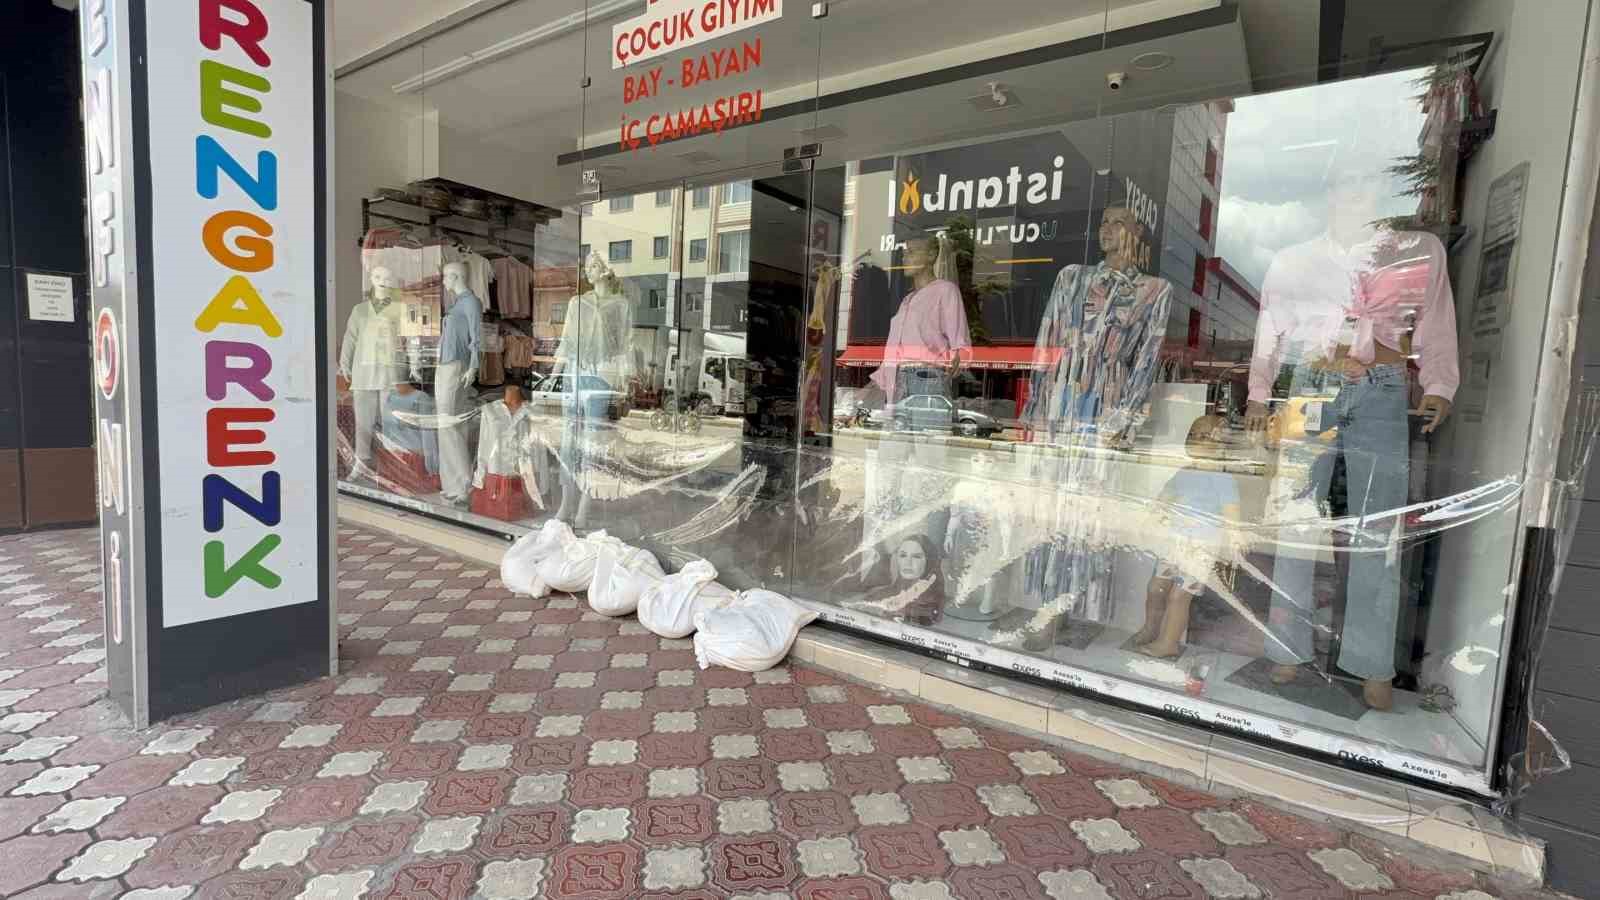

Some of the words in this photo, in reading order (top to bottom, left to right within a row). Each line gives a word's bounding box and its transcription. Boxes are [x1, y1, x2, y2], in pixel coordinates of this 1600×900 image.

[616, 9, 694, 67] ÇOCUK
[623, 66, 663, 104] BAY
[682, 37, 762, 88] BAYAN
[620, 114, 641, 154] İÇ
[646, 89, 762, 151] ÇAMAŞIRI
[195, 0, 283, 598] RENGARENK
[1162, 703, 1201, 720] axess
[1338, 749, 1385, 769] axess
